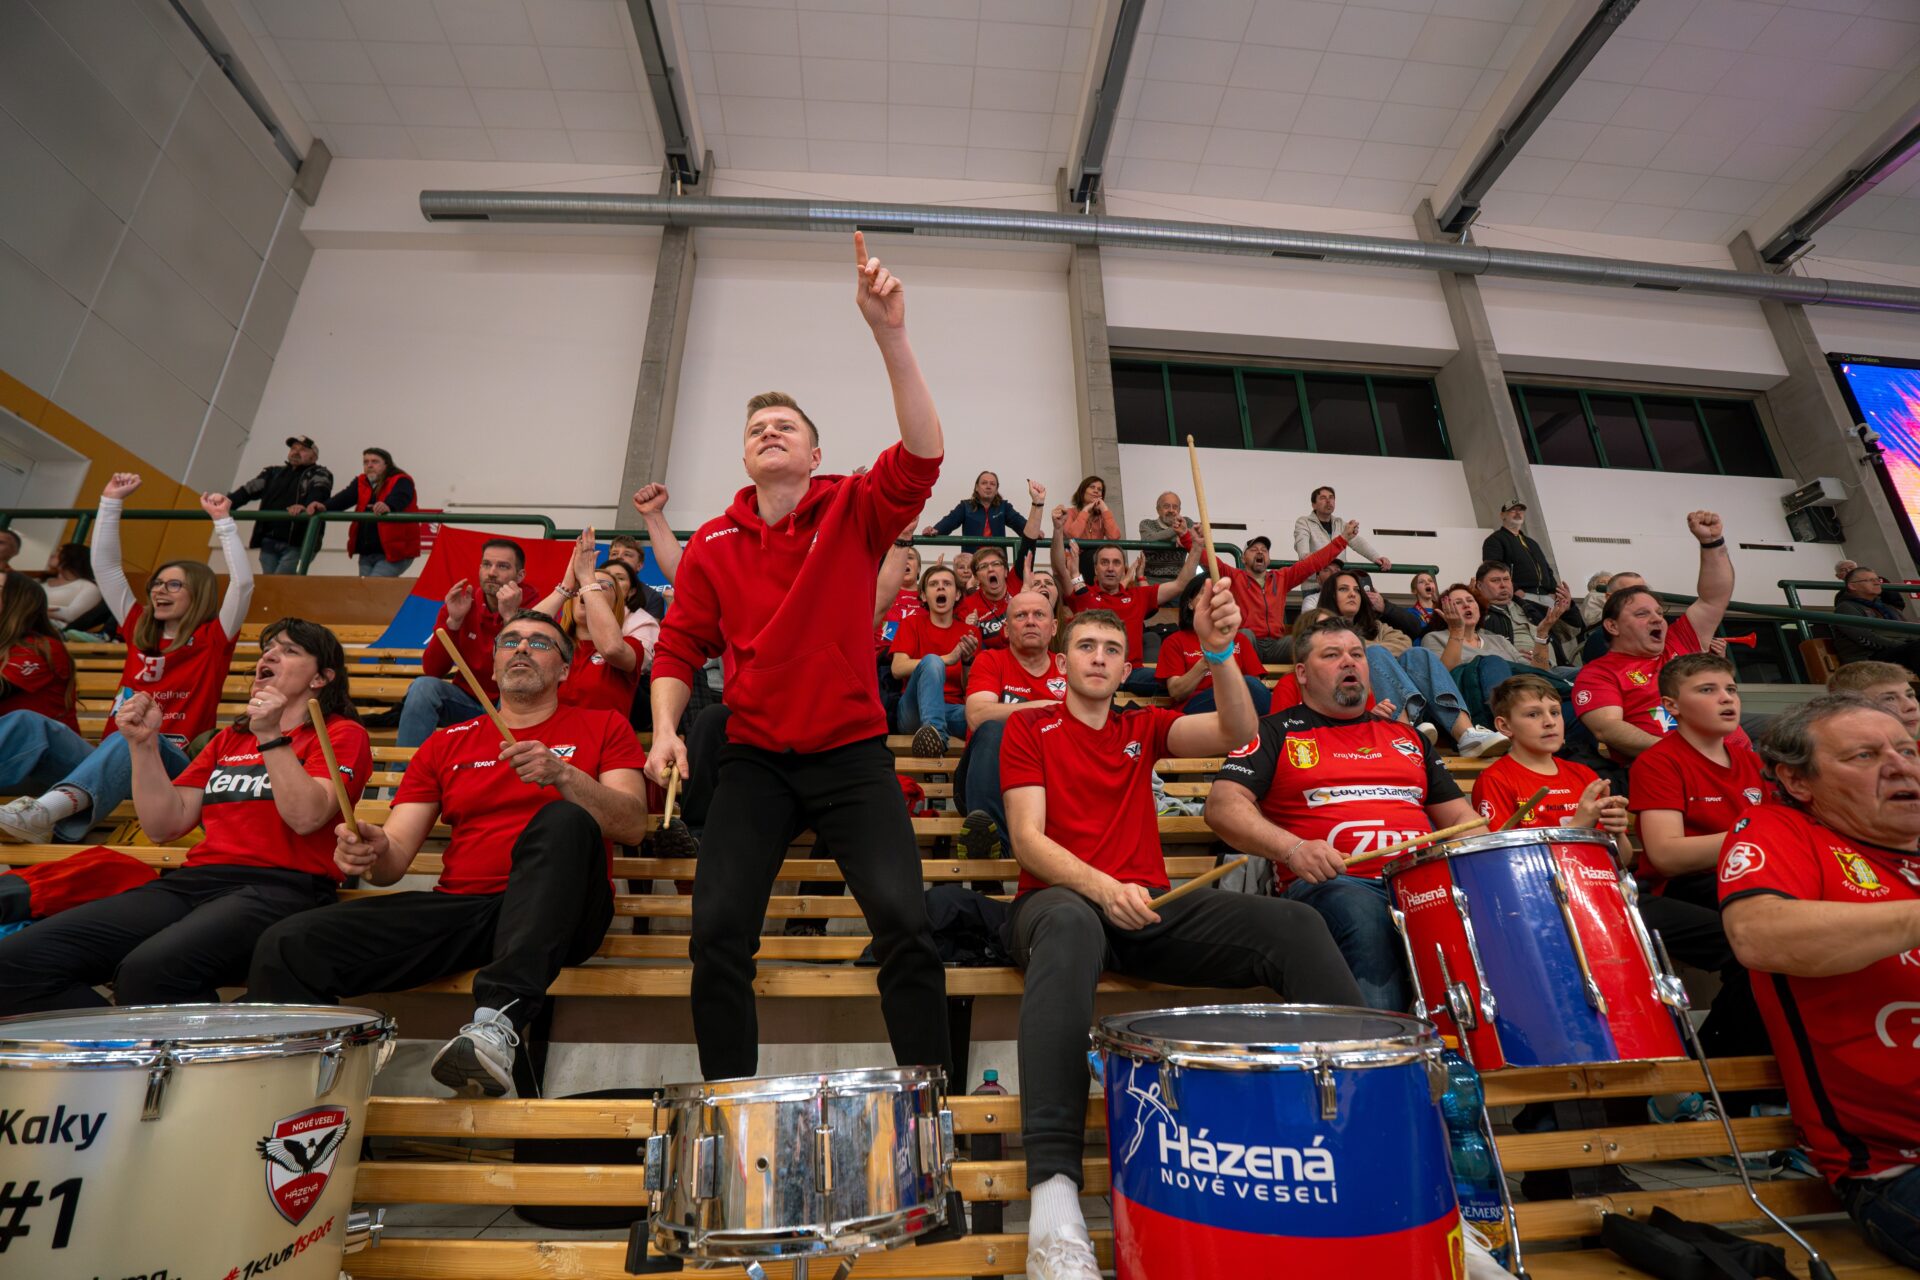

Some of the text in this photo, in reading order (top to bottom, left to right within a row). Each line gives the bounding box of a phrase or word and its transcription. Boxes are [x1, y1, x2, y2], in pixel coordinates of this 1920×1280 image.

[205, 769, 273, 798] Kemp
[1406, 884, 1447, 907] Házená
[0, 1104, 107, 1151] Kaky
[292, 1113, 336, 1132] NOVÉ VESELÍ
[1158, 1121, 1336, 1181] Házená
[1161, 1167, 1338, 1203] NOVÉ VESELÍ
[0, 1177, 83, 1254] #1
